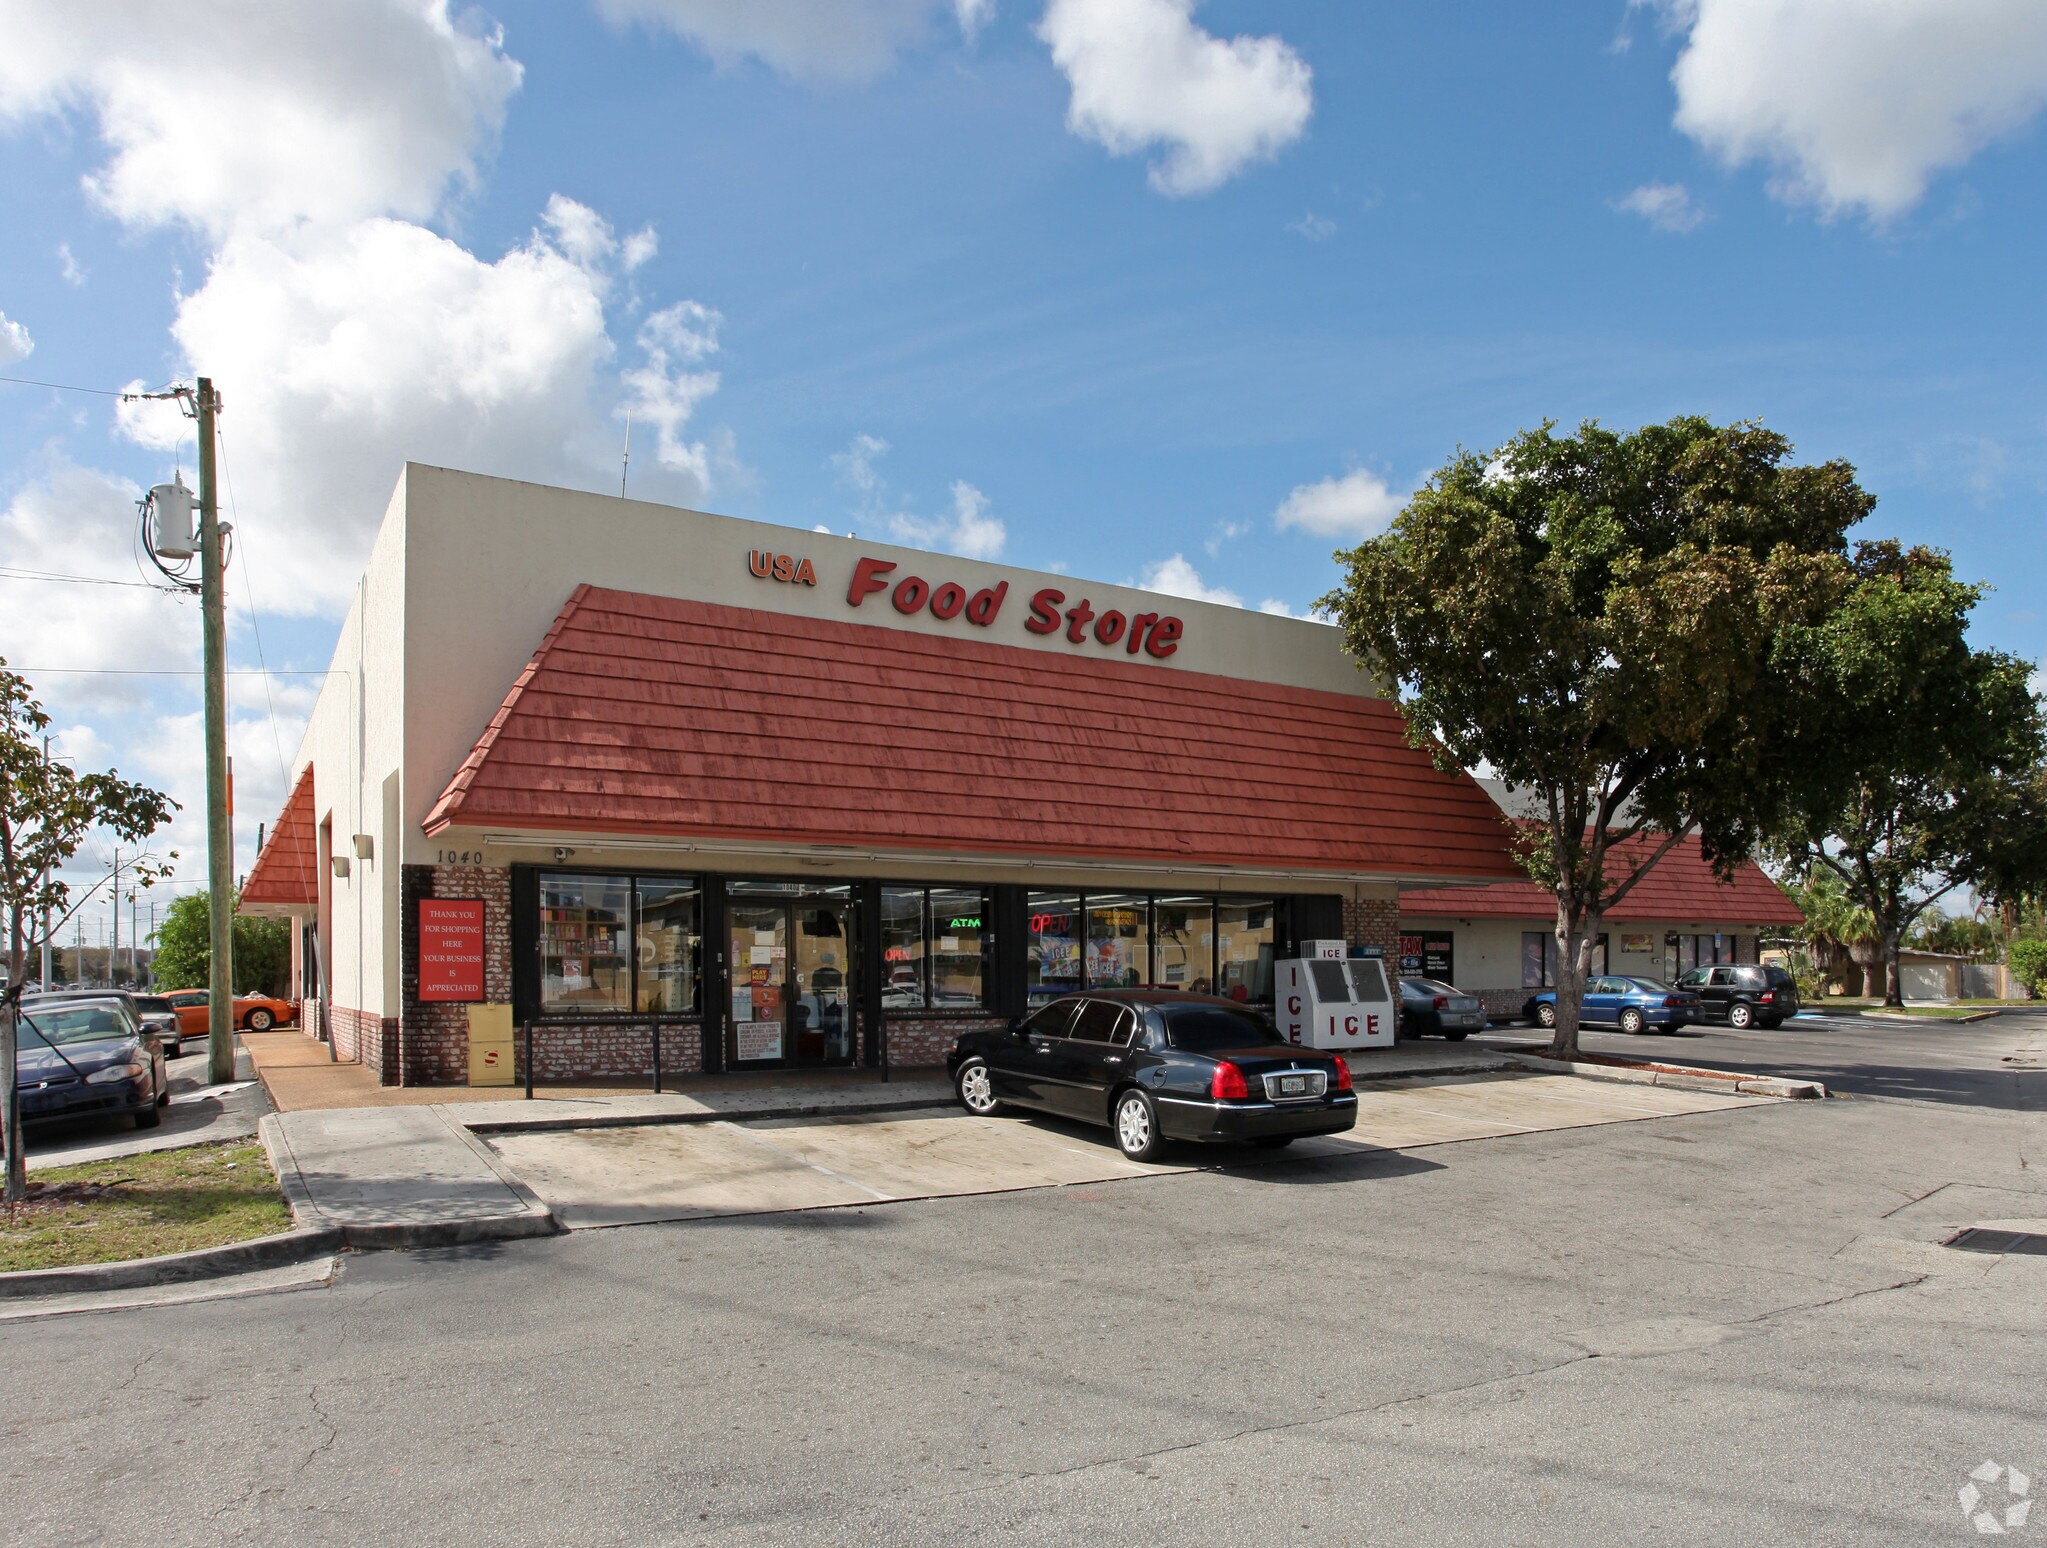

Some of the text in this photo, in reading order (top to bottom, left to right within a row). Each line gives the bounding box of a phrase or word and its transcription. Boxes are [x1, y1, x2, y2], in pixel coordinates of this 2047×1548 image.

[748, 549, 1184, 659] USA Food Store
[438, 850, 483, 865] 1040
[429, 910, 475, 919] THANK YOU
[950, 918, 981, 928] ATM
[1031, 914, 1068, 933] OPEN
[441, 925, 480, 934] SHOPPING
[442, 940, 463, 948] HERE
[1400, 936, 1423, 957] TAX
[884, 949, 911, 961] OPEN
[1051, 946, 1071, 959] ICEE
[1323, 949, 1340, 958] ICE
[446, 955, 482, 963] BUSINESS
[426, 984, 479, 992] APPRECIATED
[1288, 967, 1301, 1044] ICE
[1330, 1014, 1379, 1036] ICE
